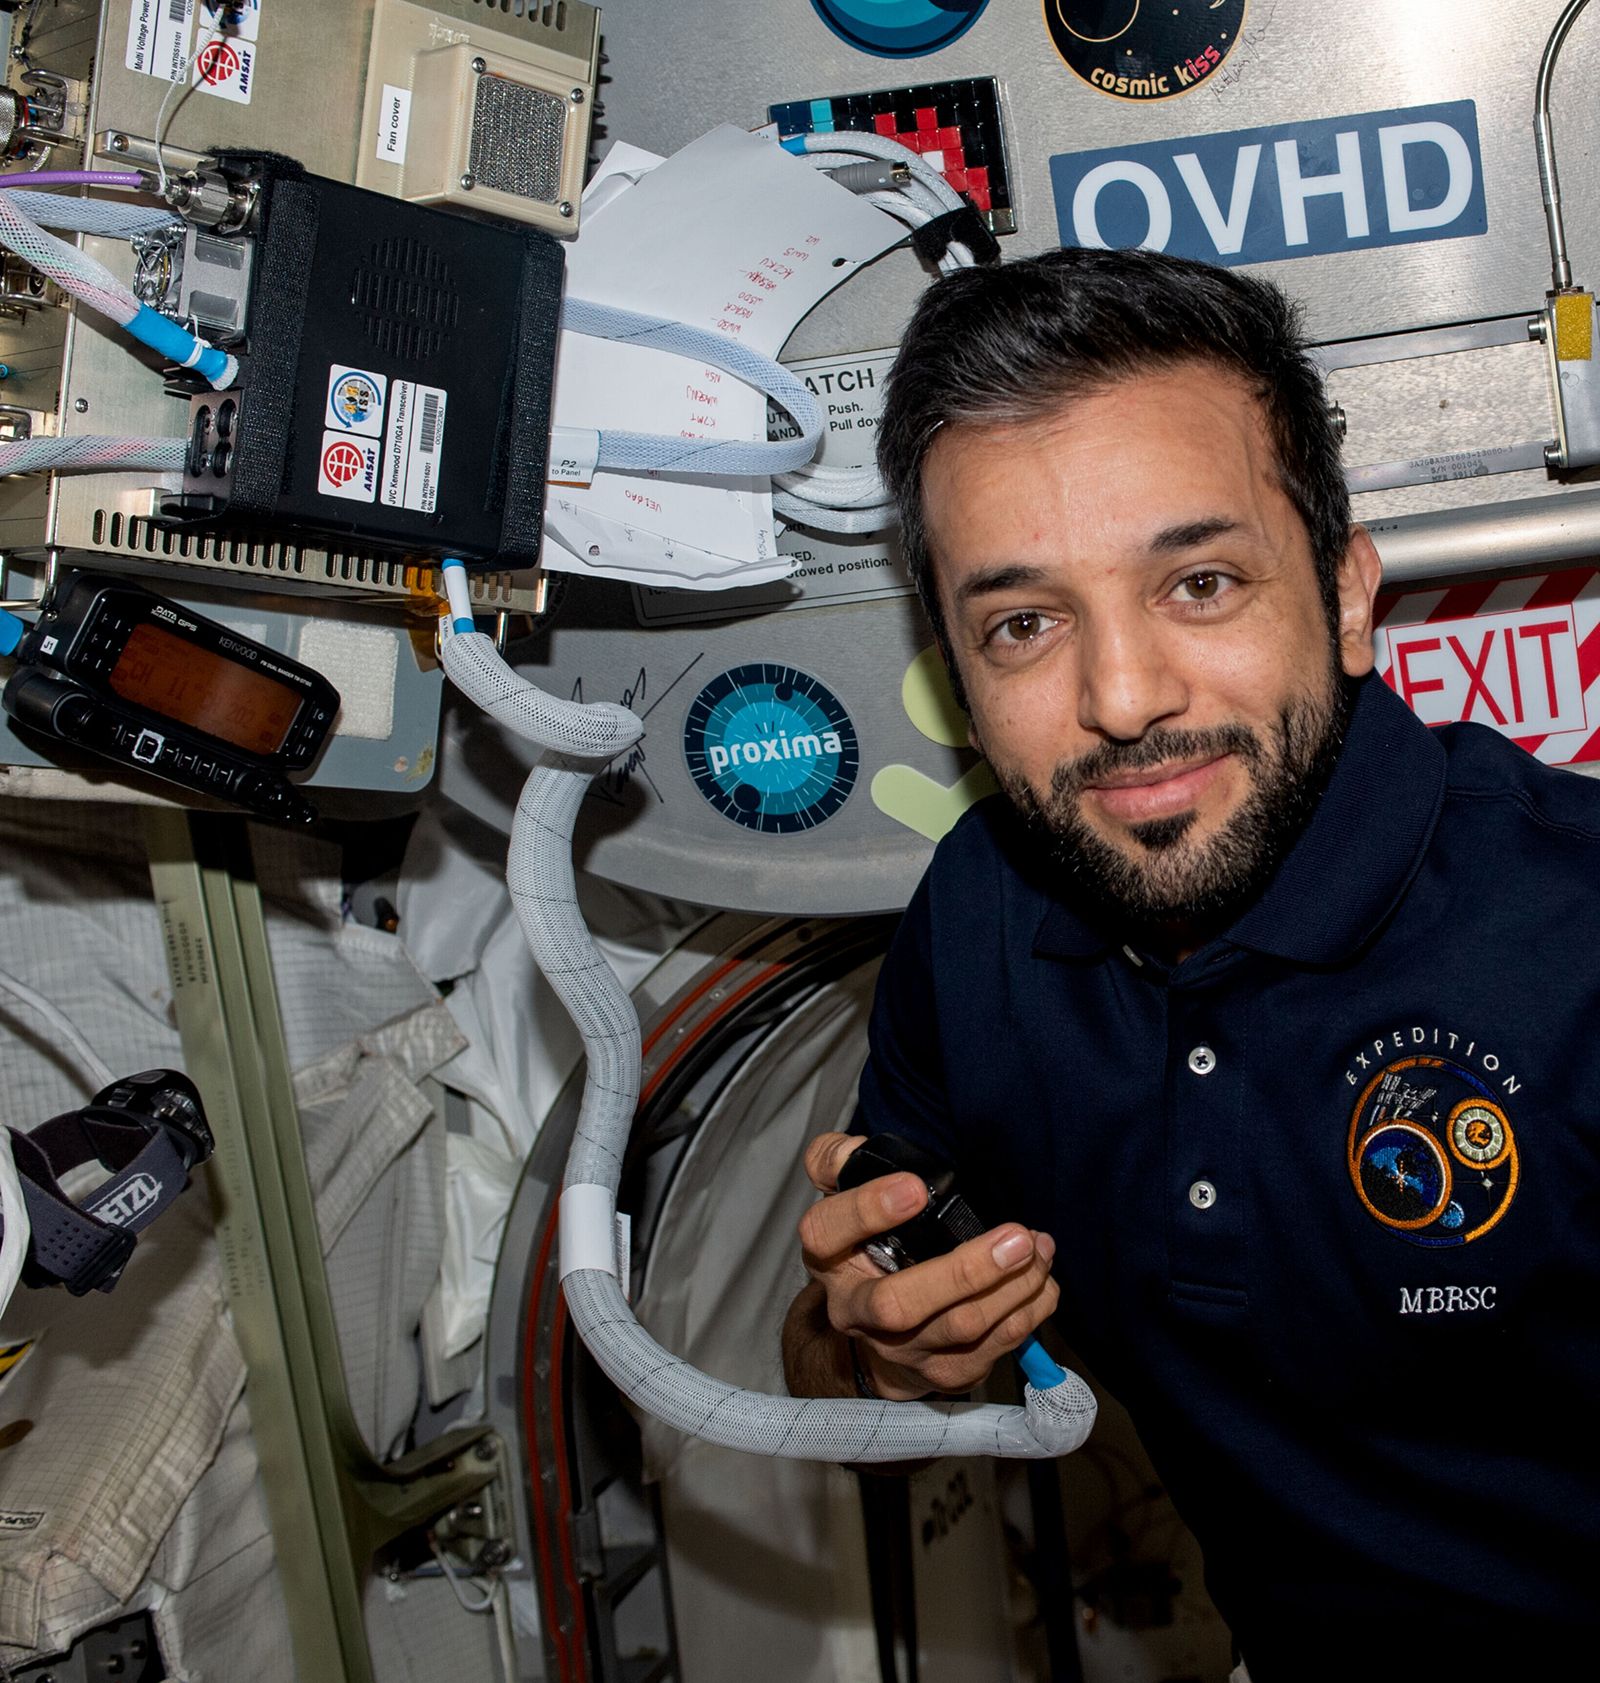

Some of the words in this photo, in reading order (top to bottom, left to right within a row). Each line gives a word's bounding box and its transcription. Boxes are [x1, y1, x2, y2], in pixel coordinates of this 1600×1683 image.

[138, 25, 147, 51] Voltage
[134, 52, 144, 70] Multi
[239, 50, 252, 94] AMSAT
[1090, 67, 1170, 96] cosmic
[1173, 44, 1221, 87] kiss
[391, 96, 401, 129] cover
[386, 131, 398, 152] Fan
[1072, 120, 1473, 256] OVHD
[804, 368, 875, 396] ATCH
[359, 390, 369, 413] ISS
[398, 382, 408, 423] Transceiver
[828, 401, 864, 416] Push.
[394, 421, 403, 453] D710GA
[829, 419, 853, 432] Pull
[363, 447, 376, 493] AMSAT
[390, 453, 401, 488] Kenwood
[552, 468, 559, 476] to
[560, 468, 581, 477] Panel
[560, 459, 577, 468] P2
[388, 489, 397, 504] JVC
[838, 557, 893, 575] position.
[156, 605, 177, 620] DATA
[218, 635, 258, 661] KENWOOD
[1396, 620, 1569, 726] EXIT
[709, 729, 843, 776] proxima
[1345, 1026, 1522, 1095] EXPEDITION
[92, 1178, 163, 1226] ETZL
[1399, 1285, 1497, 1314] MBRSC
